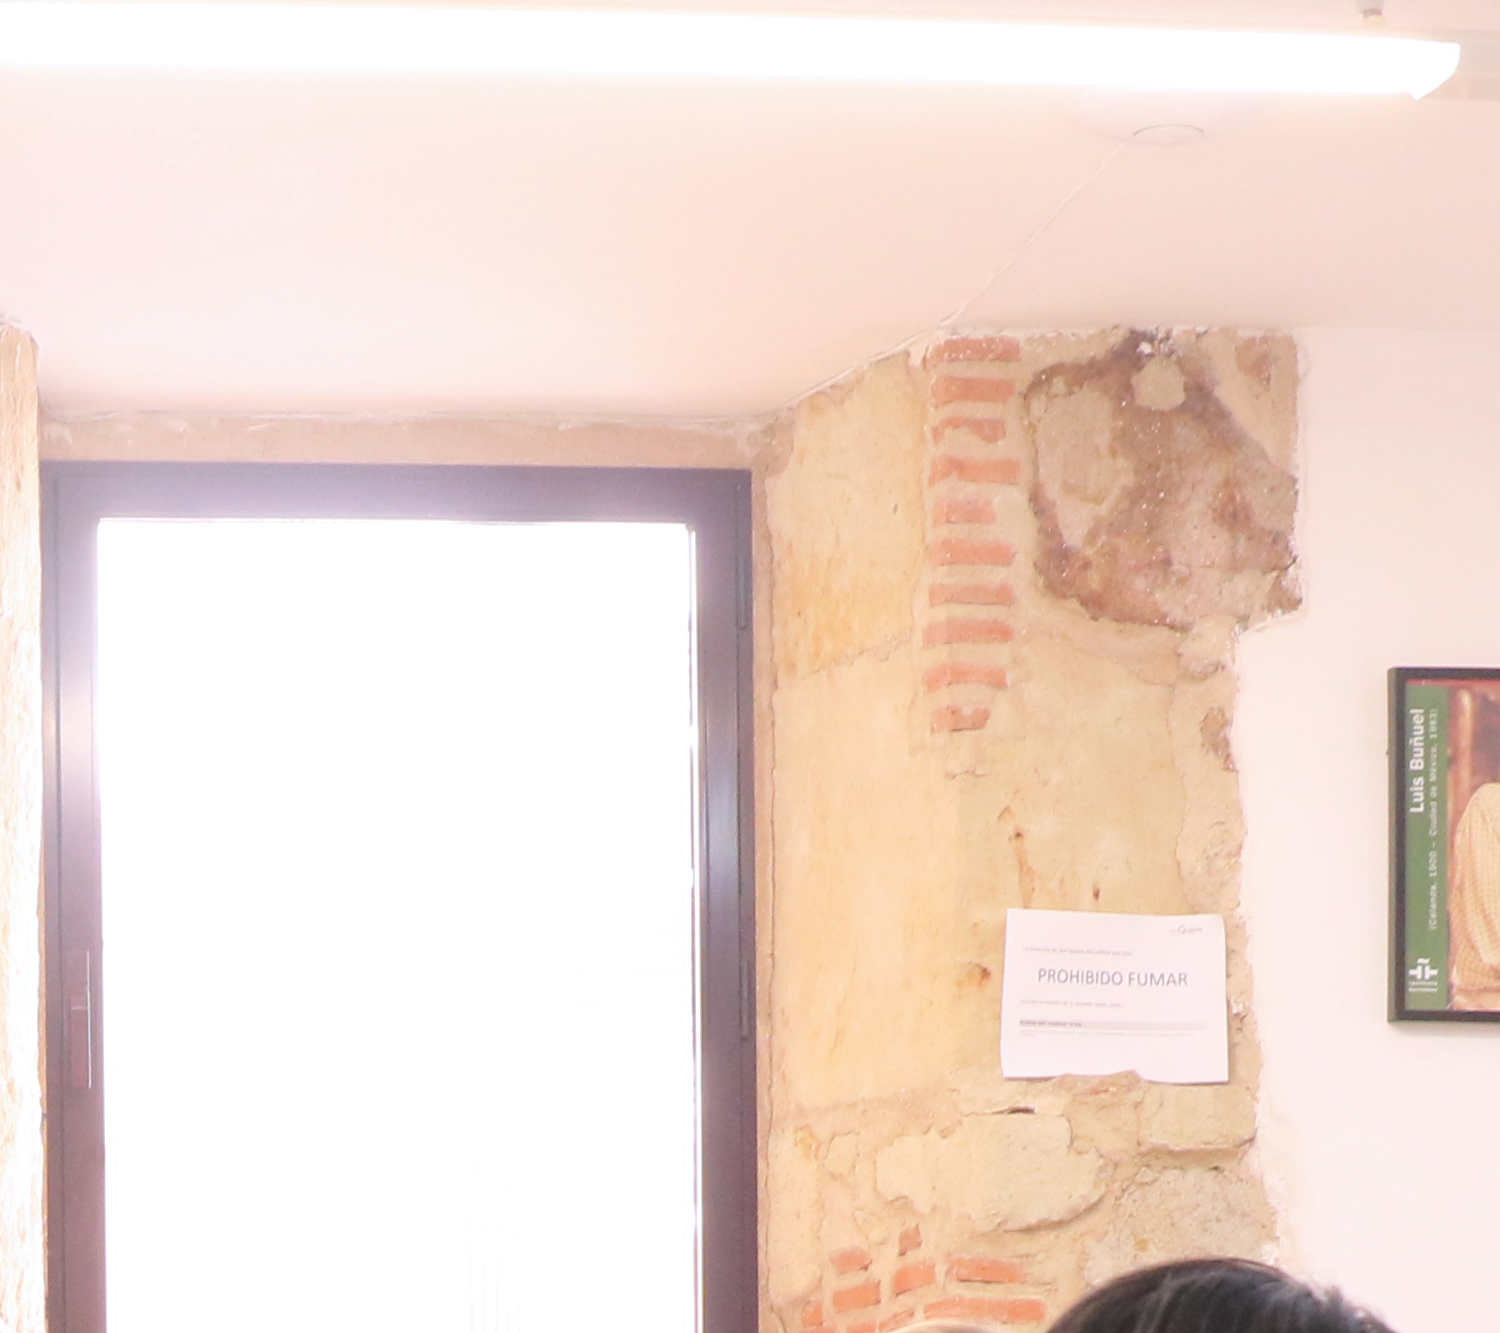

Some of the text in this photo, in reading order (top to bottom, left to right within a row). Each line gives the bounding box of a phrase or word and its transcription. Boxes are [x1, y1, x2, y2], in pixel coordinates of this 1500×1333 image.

[1409, 708, 1425, 813] Luis Buñuel
[1037, 968, 1188, 987] PROHIBIDO FUMAR
